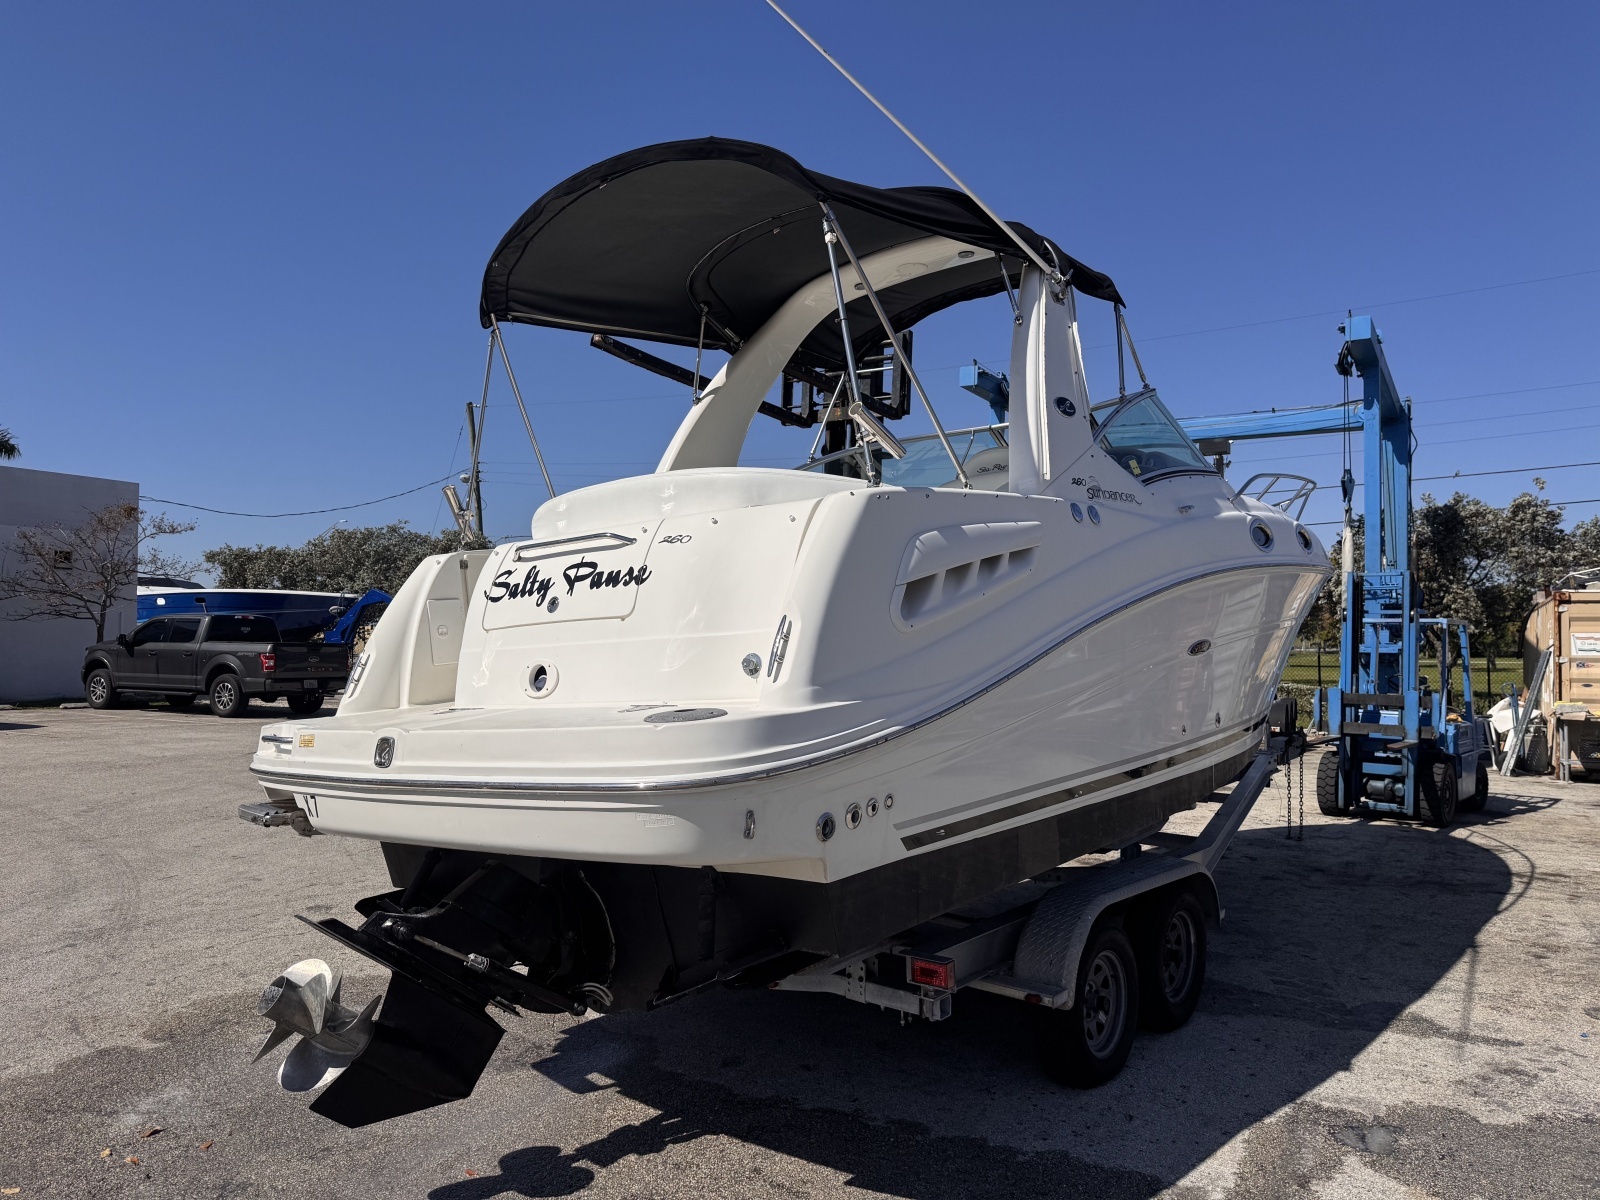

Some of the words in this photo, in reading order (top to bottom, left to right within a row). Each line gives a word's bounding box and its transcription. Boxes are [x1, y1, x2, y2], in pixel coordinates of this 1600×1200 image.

[1071, 477, 1087, 487] 260
[658, 534, 692, 544] 260
[484, 565, 555, 607] Salty
[563, 556, 652, 596] Pause
